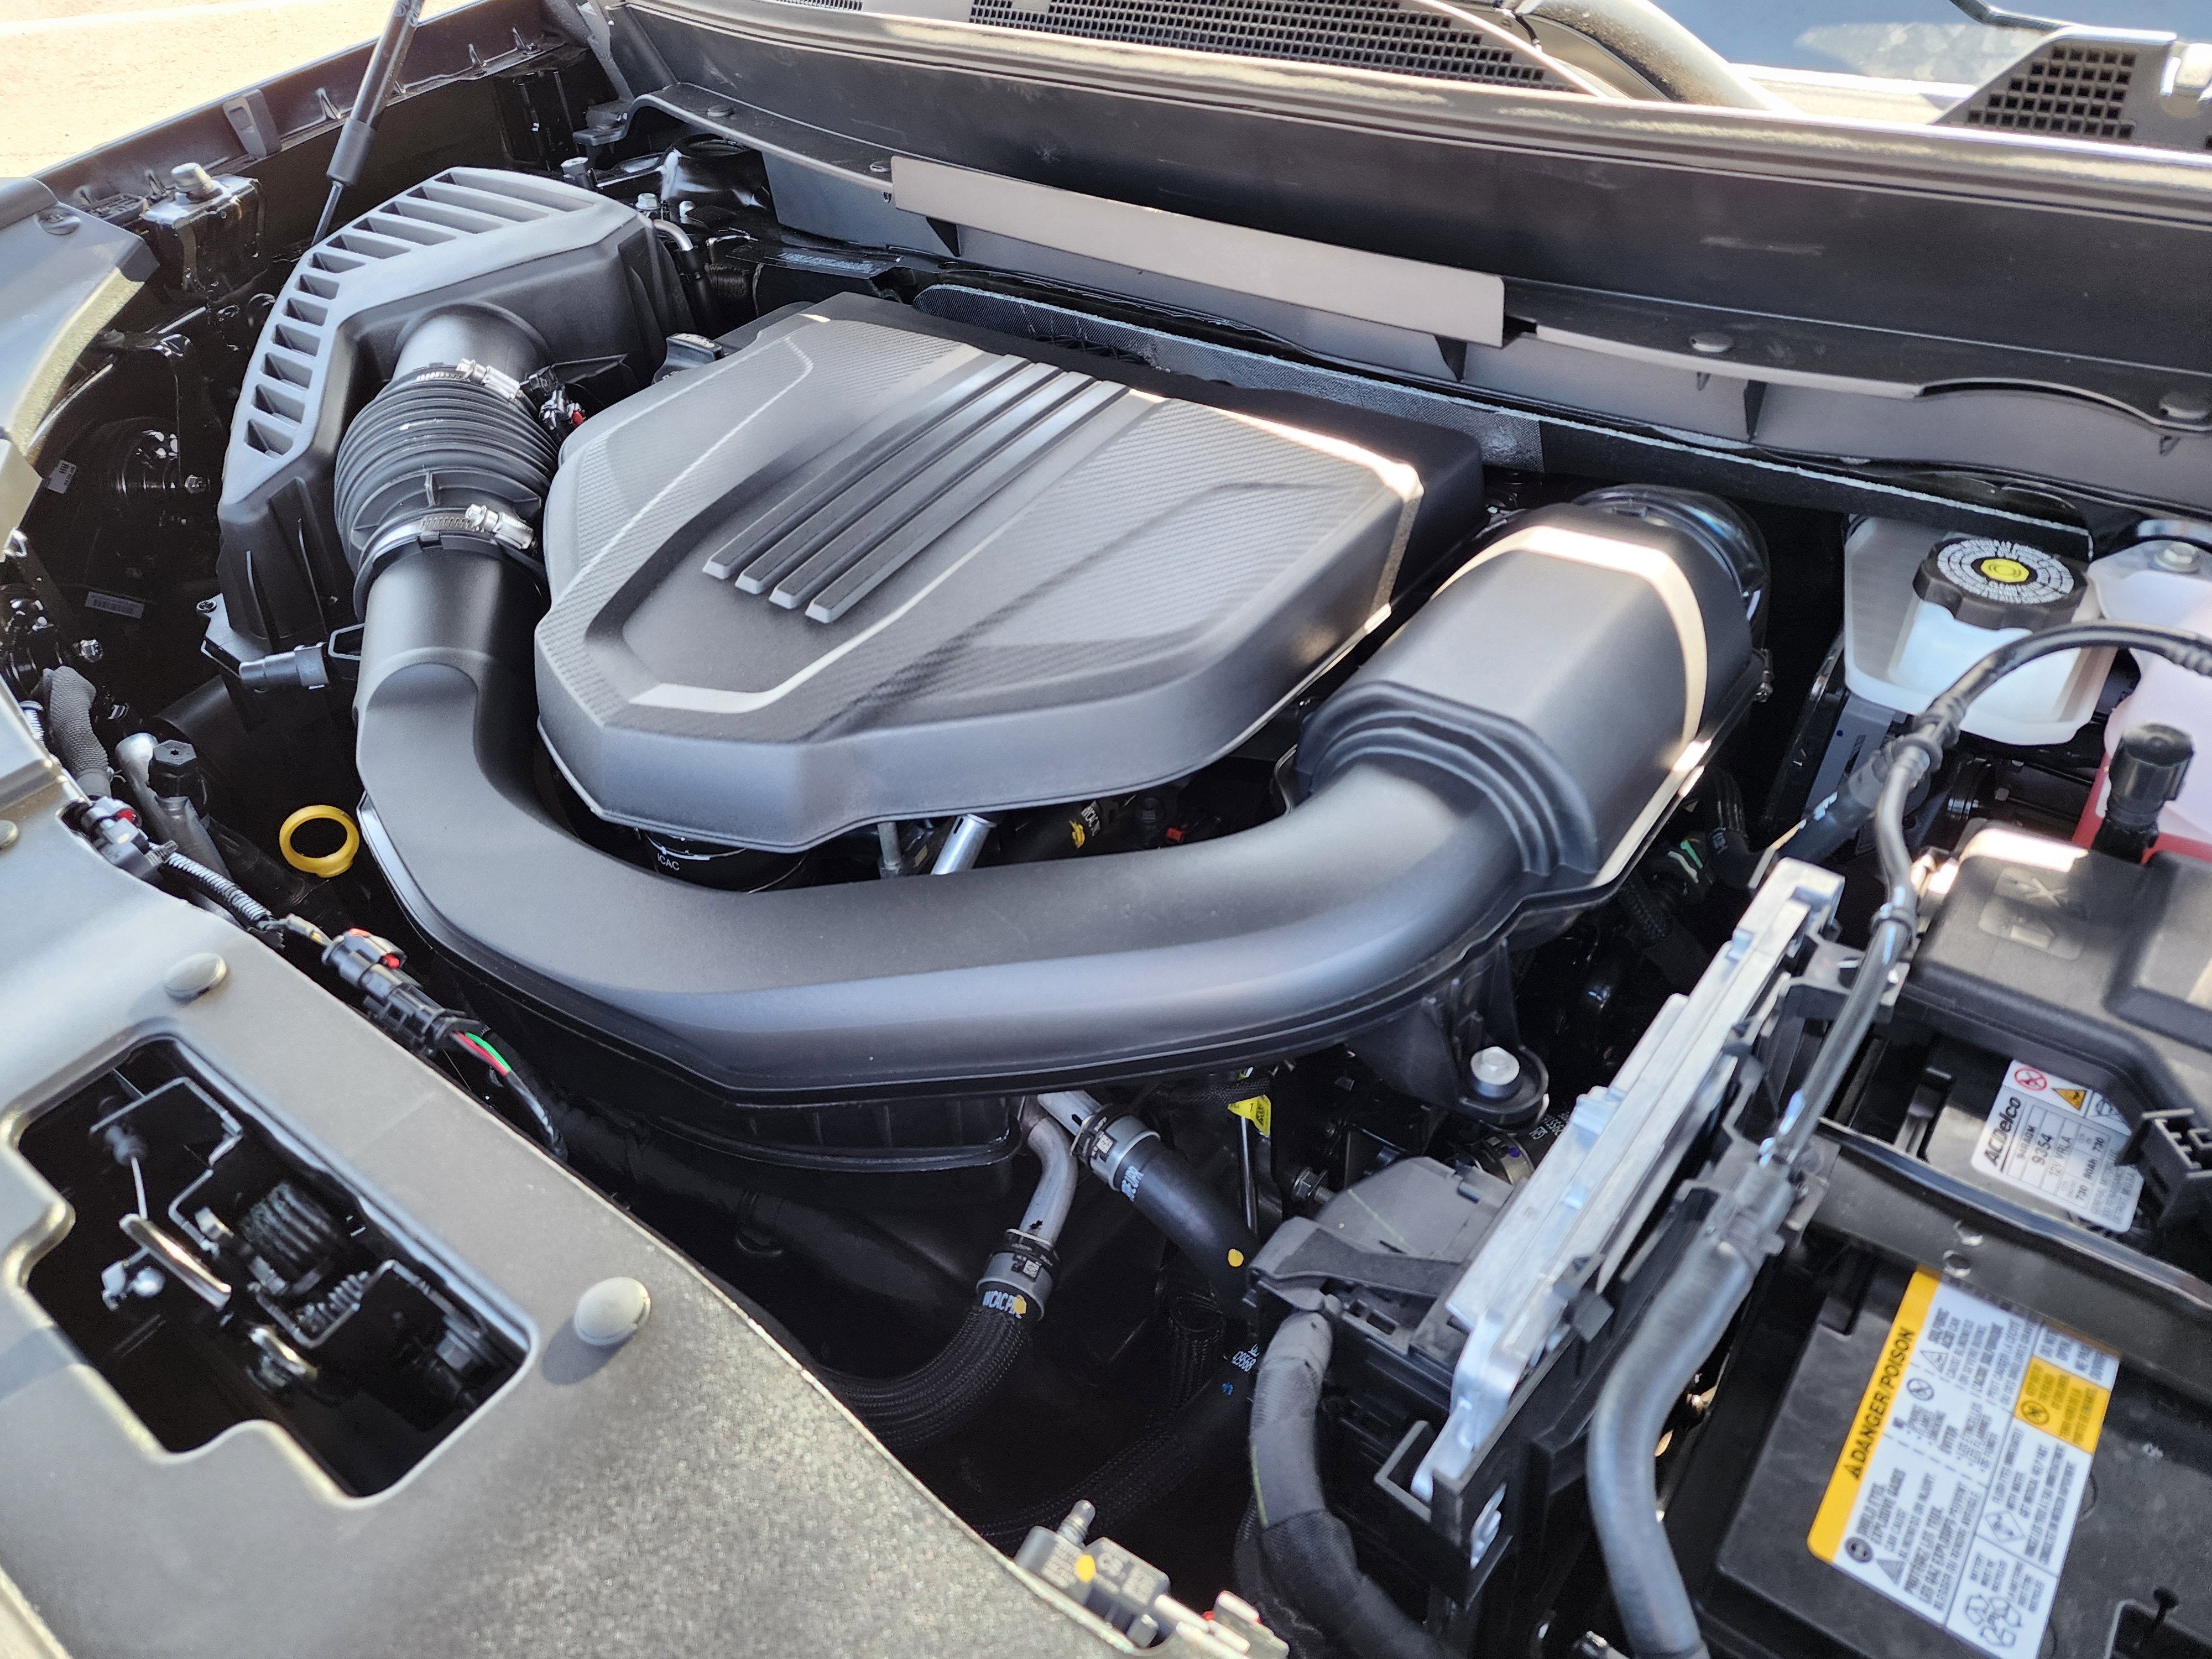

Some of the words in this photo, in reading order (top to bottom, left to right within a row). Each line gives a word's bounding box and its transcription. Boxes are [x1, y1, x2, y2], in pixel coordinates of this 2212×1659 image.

[1984, 1096, 2022, 1166] ACDelco
[2092, 1136, 2105, 1154] 730
[2031, 1132, 2053, 1166] 9354
